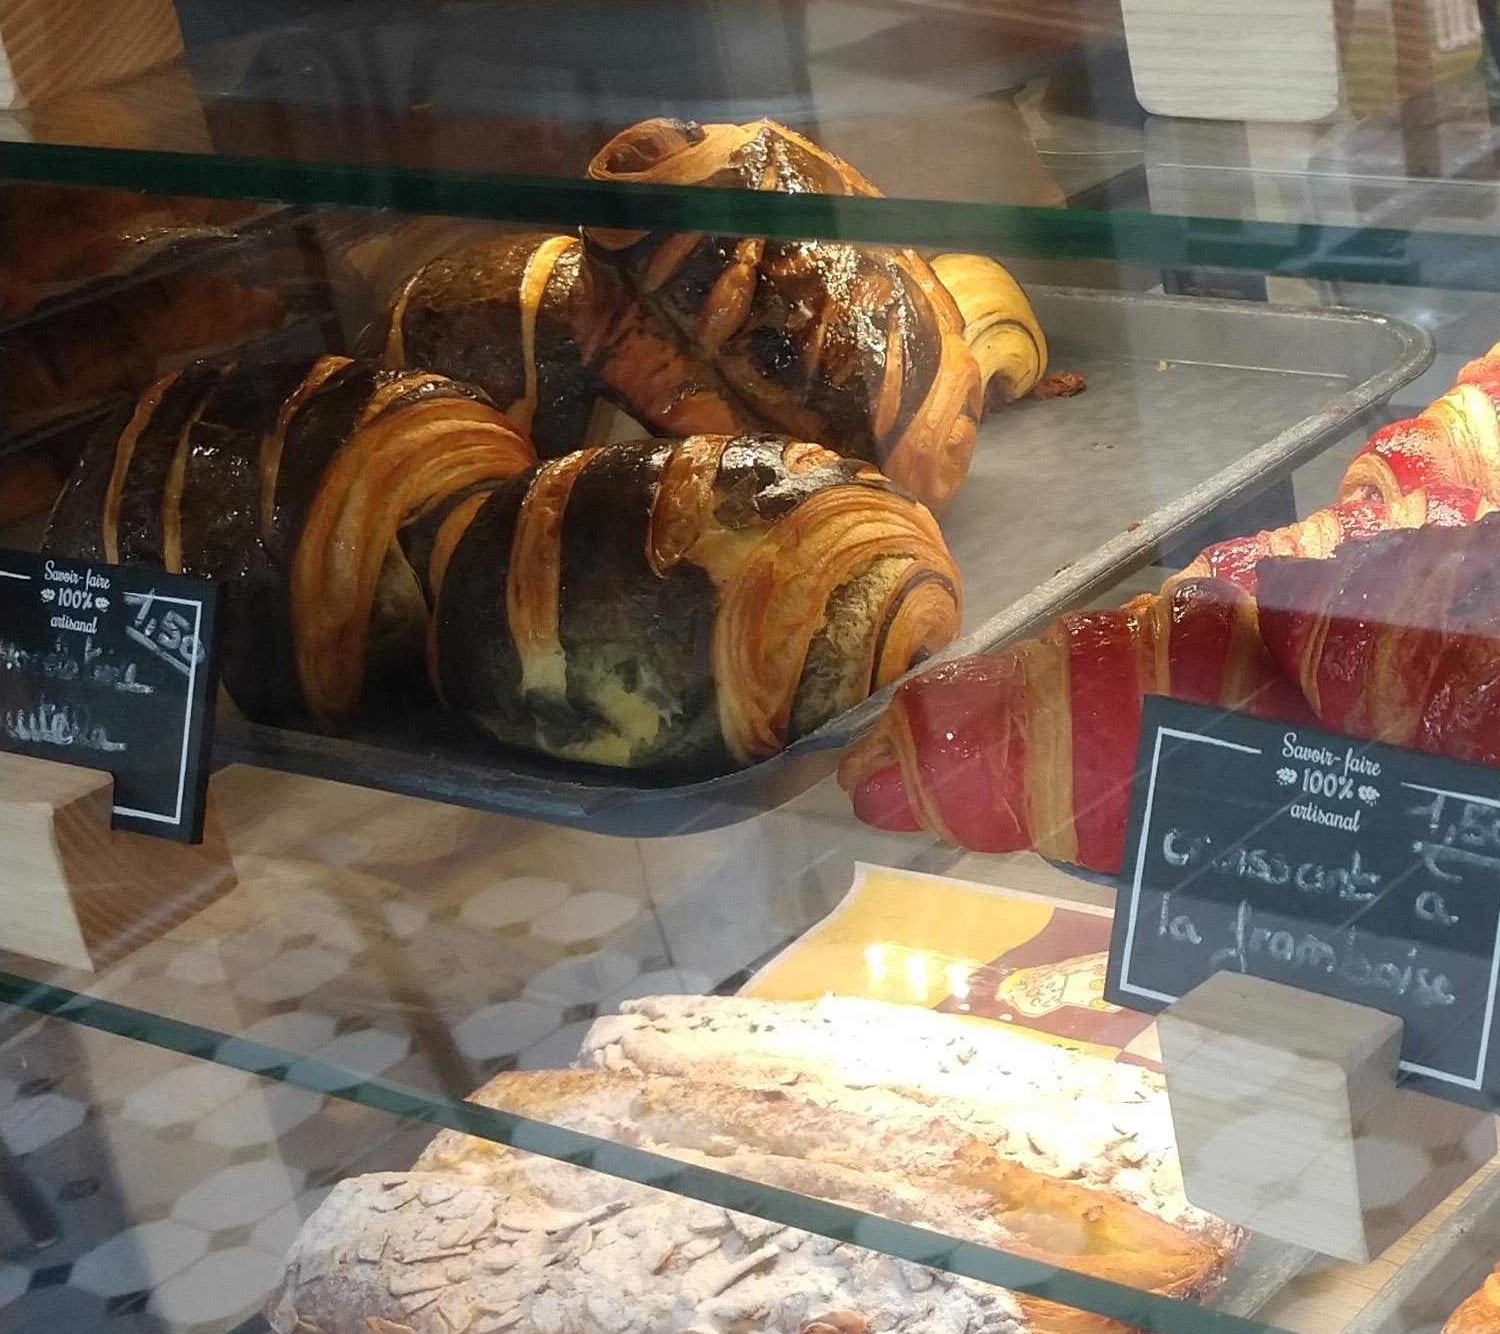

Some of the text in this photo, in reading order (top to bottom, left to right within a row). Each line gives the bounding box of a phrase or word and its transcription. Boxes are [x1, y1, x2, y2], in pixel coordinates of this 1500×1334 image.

[57, 587, 93, 610] 100%
[50, 614, 98, 634] artisanal
[1302, 768, 1354, 800] 100%
[1290, 802, 1361, 832] artisanal
[1157, 892, 1203, 945] la
